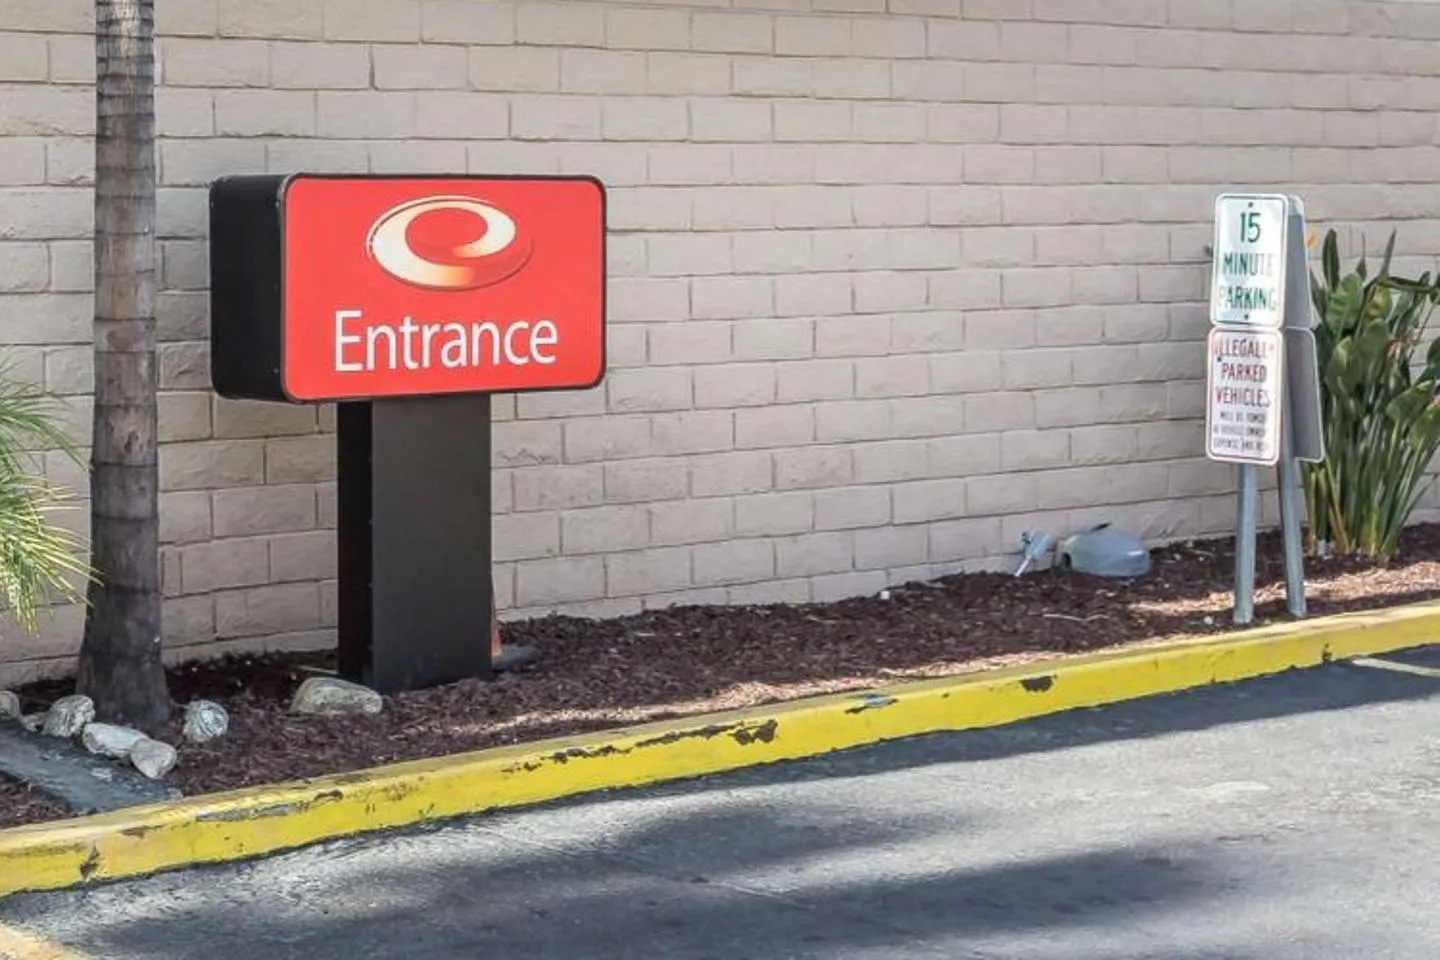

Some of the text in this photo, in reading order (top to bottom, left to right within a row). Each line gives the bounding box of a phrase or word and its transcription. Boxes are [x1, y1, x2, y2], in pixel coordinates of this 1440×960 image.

[1240, 211, 1262, 243] 15
[1222, 251, 1275, 276] MINUTE
[1218, 285, 1277, 310] PARKING
[333, 310, 558, 372] Entrance
[1220, 362, 1267, 383] PARKED
[1214, 386, 1272, 408] VEHICLES
